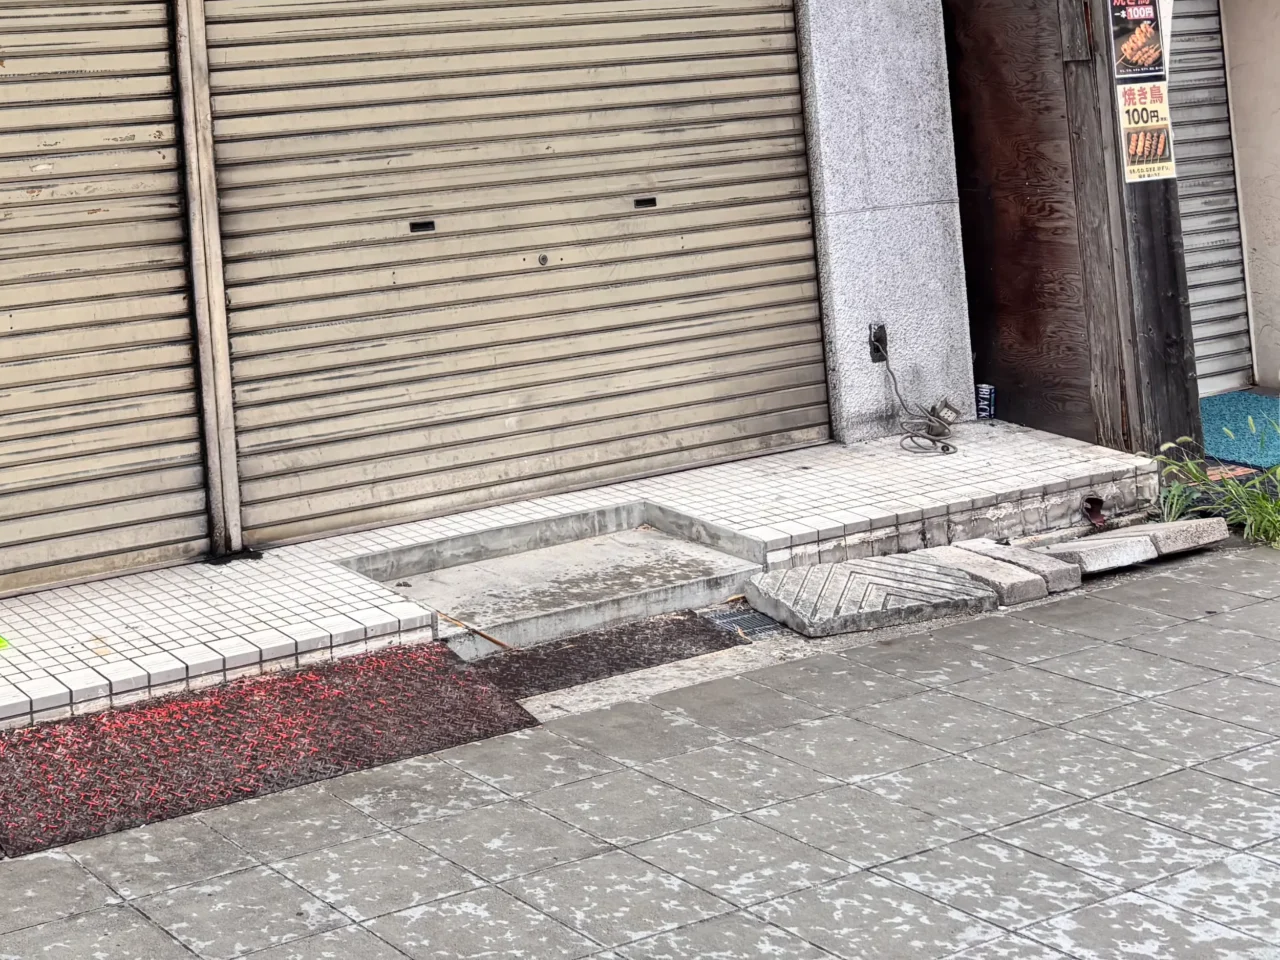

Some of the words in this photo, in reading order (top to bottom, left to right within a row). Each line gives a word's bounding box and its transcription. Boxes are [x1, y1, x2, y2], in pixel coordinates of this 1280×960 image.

[1122, 85, 1163, 106] 焼き鳥
[1125, 107, 1160, 125] 100円
[978, 388, 990, 418] BLACK
